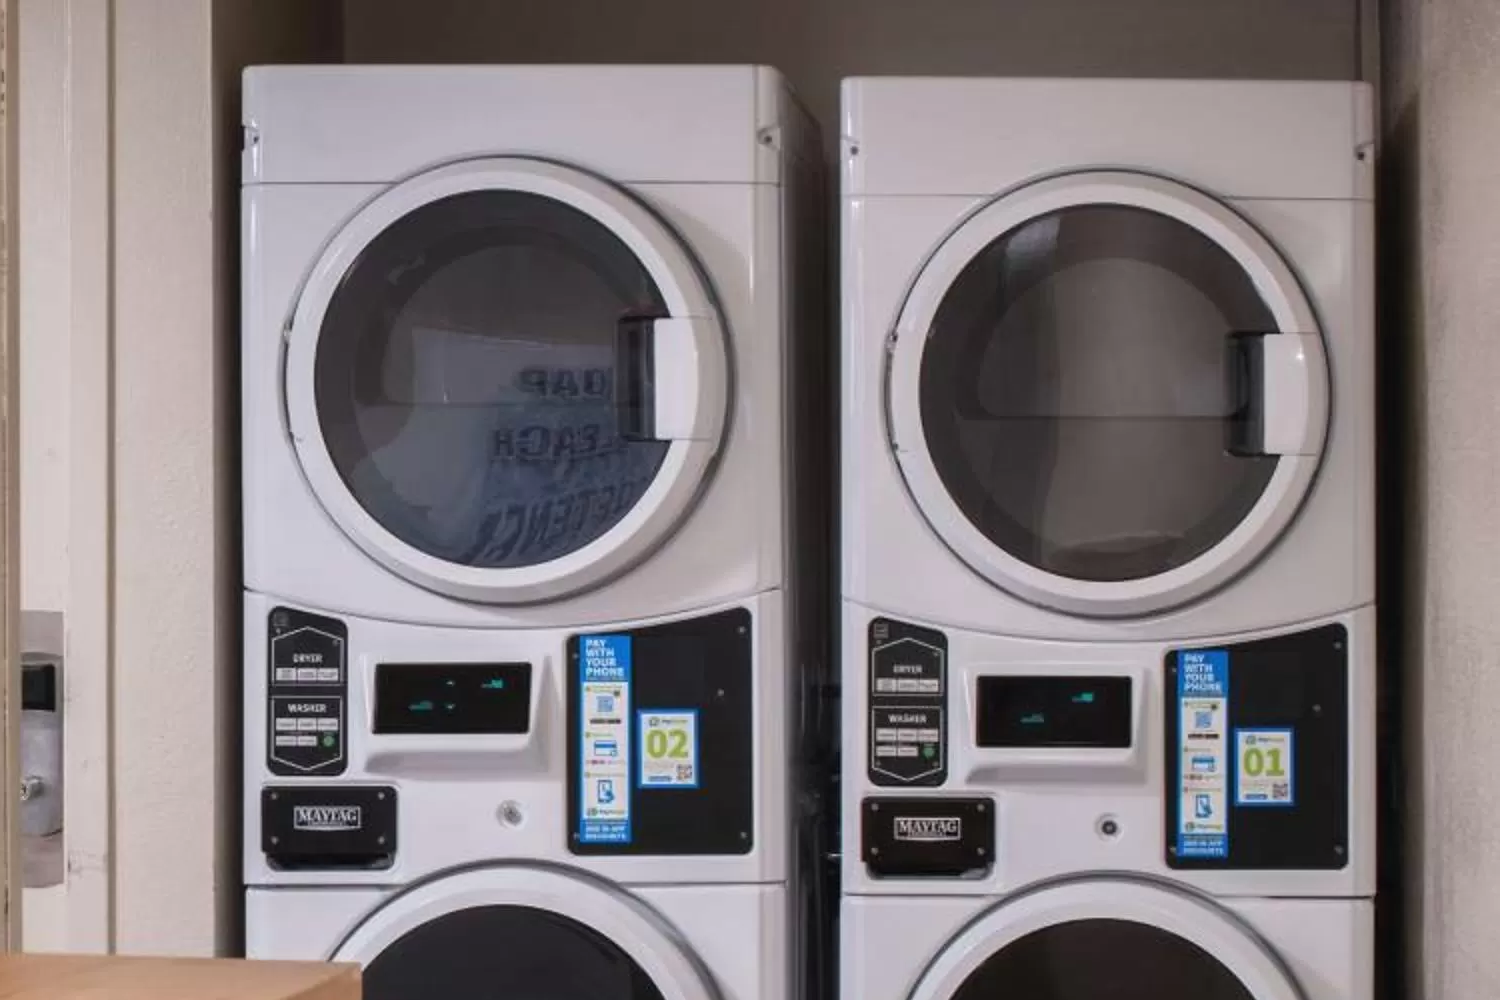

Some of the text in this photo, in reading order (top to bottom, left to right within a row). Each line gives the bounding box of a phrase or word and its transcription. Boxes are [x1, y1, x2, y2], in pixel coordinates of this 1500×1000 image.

[586, 639, 607, 647] PAY
[586, 648, 615, 657] WITH
[586, 657, 617, 667] YOUR
[586, 667, 624, 677] PHONE
[287, 703, 327, 713] WASHER
[647, 728, 689, 759] 02
[1243, 747, 1285, 777] 01
[299, 807, 357, 822] MAYTAG
[900, 820, 957, 833] MAYTAG
